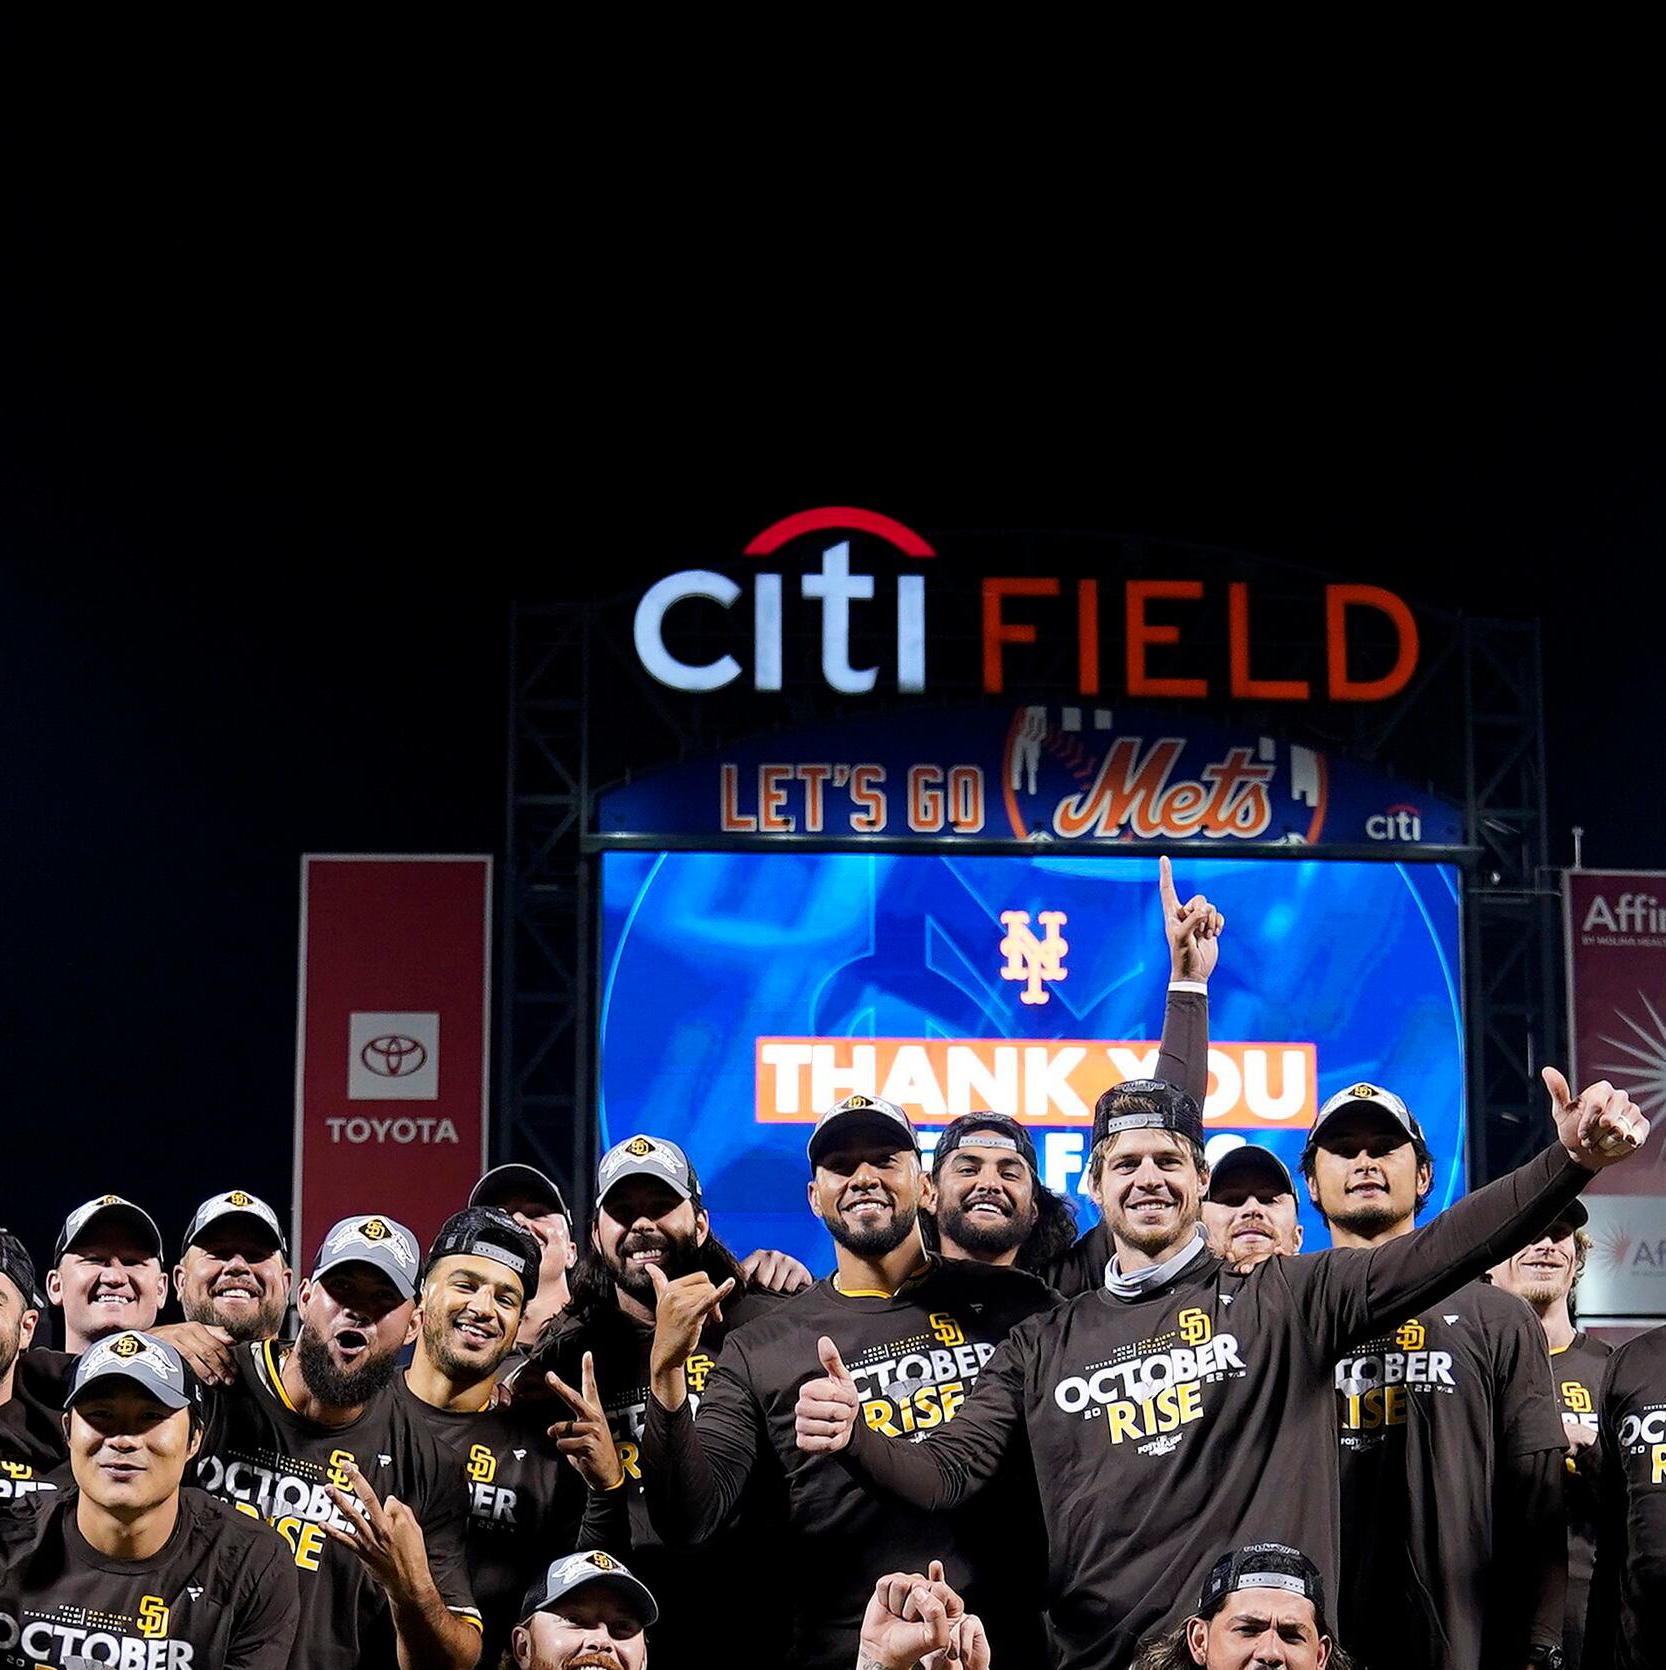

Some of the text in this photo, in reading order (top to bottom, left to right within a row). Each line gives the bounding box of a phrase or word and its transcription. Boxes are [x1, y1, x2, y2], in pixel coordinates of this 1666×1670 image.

[632, 539, 1420, 703] citi FIELD
[720, 736, 1273, 841] LET'S GO Mets
[1365, 813, 1422, 842] citi
[762, 1044, 1089, 1118] THANK
[326, 1117, 459, 1144] TOYOTA
[930, 1312, 965, 1348] SD
[1177, 1308, 1211, 1346] SD
[1395, 1319, 1425, 1350] SD
[1053, 1333, 1248, 1415] OCTOBER
[1206, 1372, 1224, 1382] 22
[865, 1380, 965, 1436] RISE
[1084, 1408, 1101, 1420] 20
[1108, 1384, 1205, 1444] RISE
[1562, 1382, 1592, 1414] SD
[467, 1445, 497, 1483] SD
[137, 1595, 170, 1640] SD
